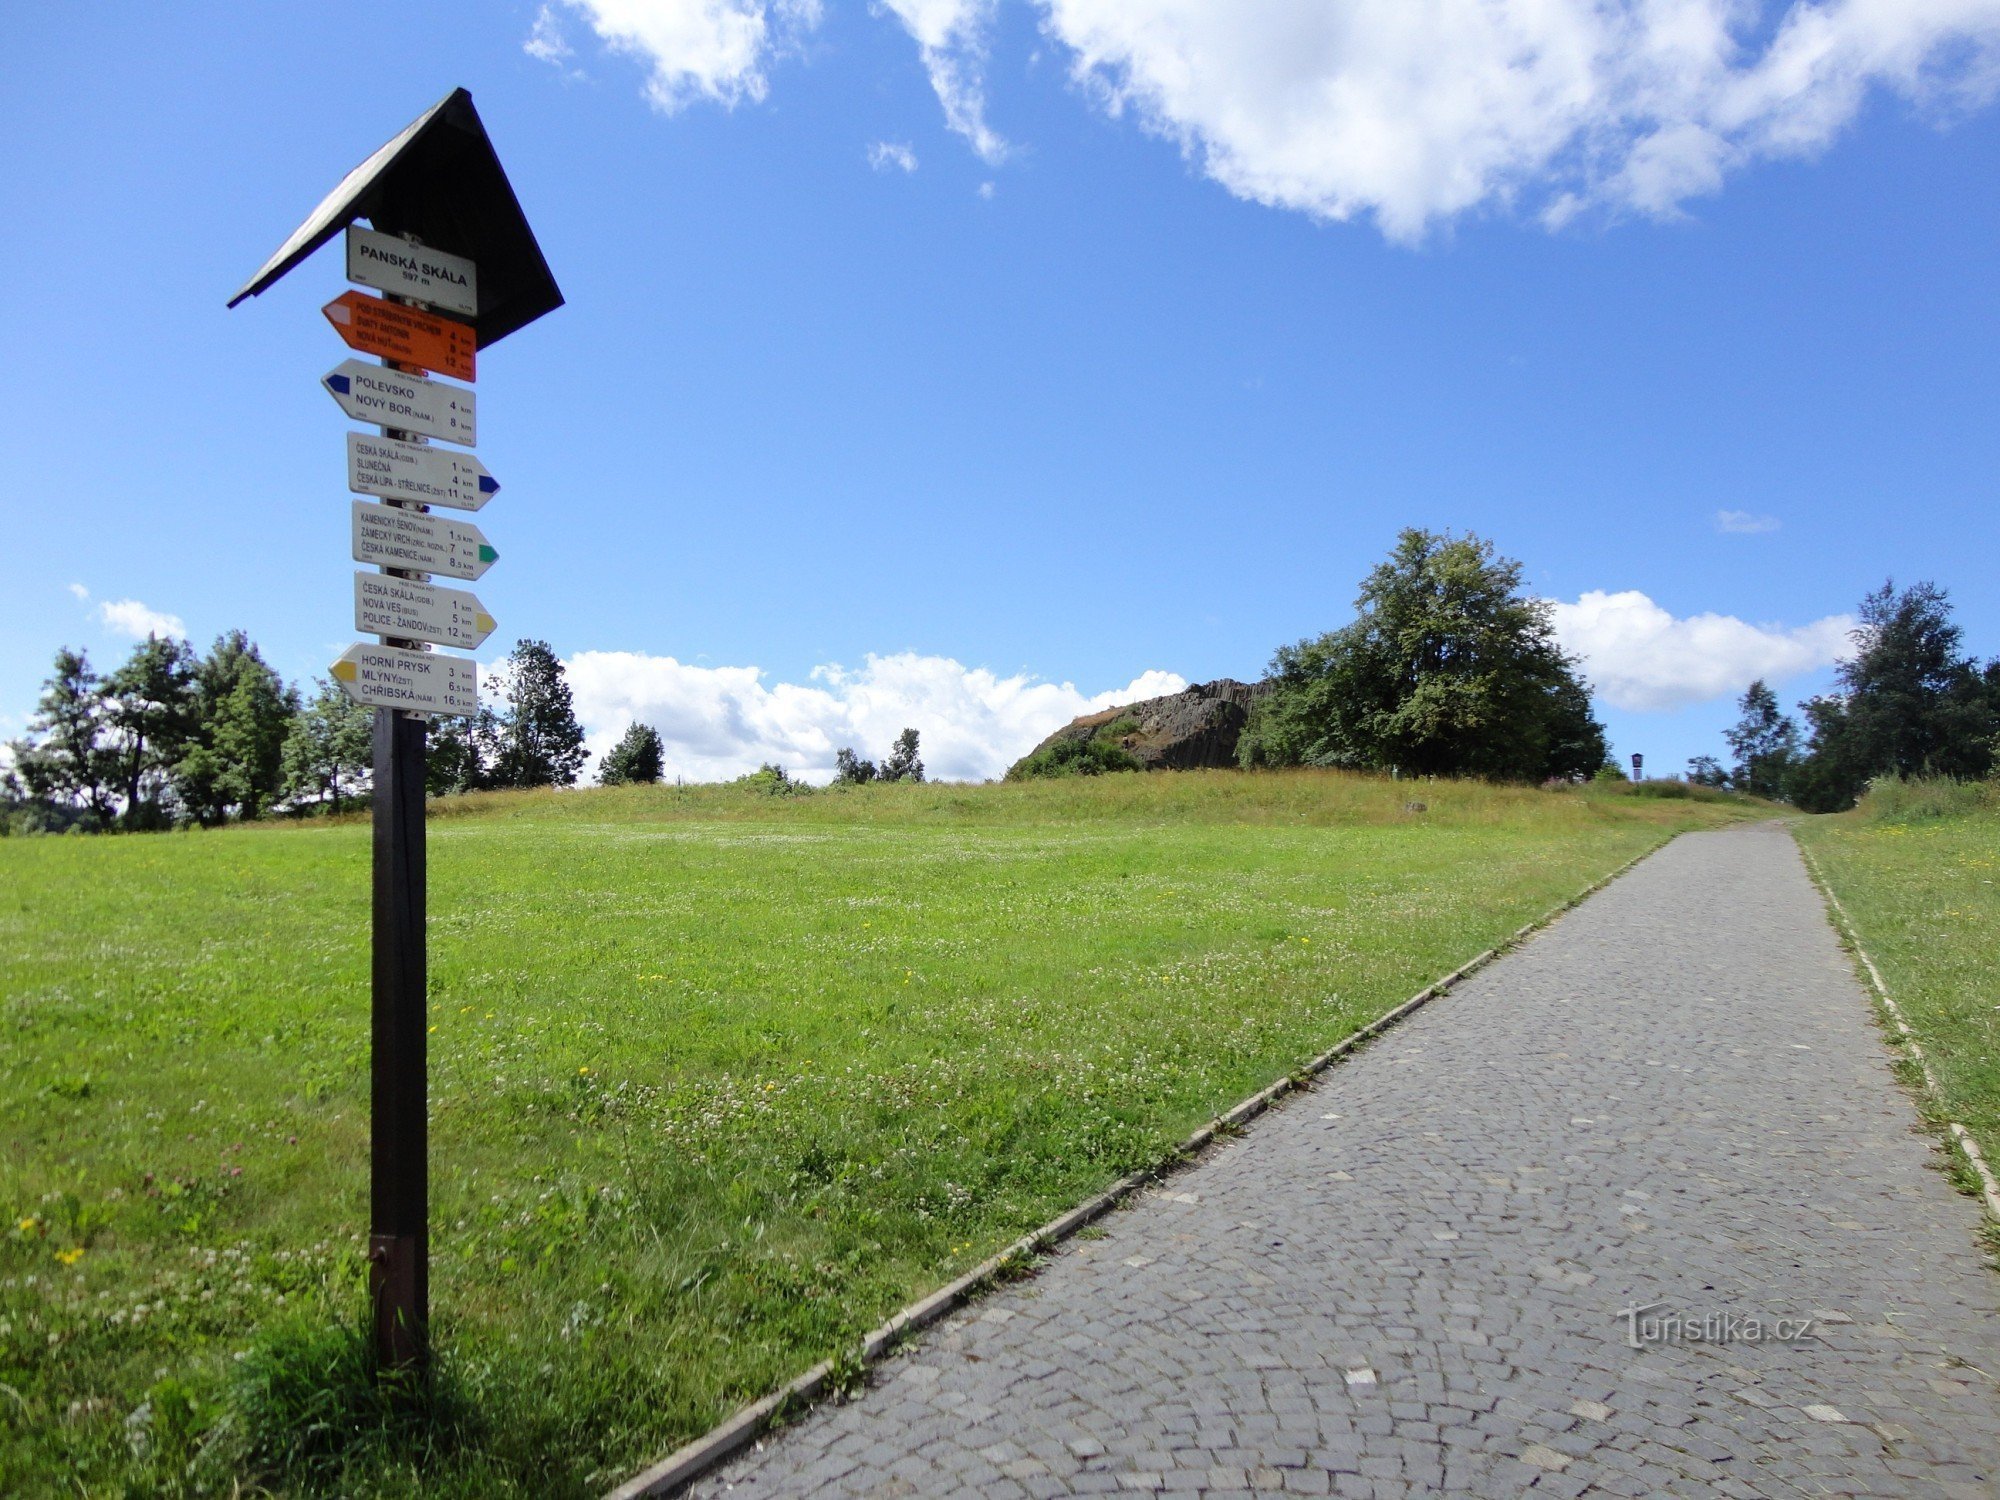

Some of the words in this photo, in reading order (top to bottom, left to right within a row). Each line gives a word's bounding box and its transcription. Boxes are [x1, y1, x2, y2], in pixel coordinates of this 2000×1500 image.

[360, 246, 418, 271] PANSKÁ
[422, 263, 467, 287] SKÁLA
[403, 271, 418, 283] 597
[422, 277, 429, 285] m
[356, 375, 414, 399] POLEVSKO
[450, 401, 456, 410] 4
[461, 406, 472, 414] km
[356, 394, 385, 410] NOVÝ
[389, 403, 411, 415] BOR
[450, 418, 456, 427] 8
[356, 443, 377, 456] ČESKÁ
[379, 447, 399, 460] SKÁLA
[452, 463, 456, 471] 1
[462, 466, 472, 474] km
[357, 458, 391, 473] SLUNEČNÁ
[452, 476, 458, 485] 4
[463, 480, 473, 488] km
[357, 472, 378, 485] ČESKÁ
[379, 476, 393, 487] LÍPA
[398, 478, 431, 493] STŘELNICE
[448, 489, 458, 498] 11
[463, 493, 474, 501] km
[361, 513, 395, 529] KAMENICKÝ
[361, 527, 392, 542] ZÁMECKÝ
[394, 533, 410, 544] VRCH
[450, 544, 455, 552] 7
[463, 549, 473, 557] km
[362, 541, 383, 554] ČESKÁ
[385, 546, 417, 560] KAMENICE
[463, 562, 473, 570] km
[363, 582, 388, 596] ČESKÁ
[390, 588, 414, 601] SKÁLA
[452, 601, 457, 609] 1
[363, 598, 384, 611] NOVÁ
[387, 602, 401, 613] VES
[452, 614, 458, 623] 5
[462, 618, 472, 626] km
[363, 612, 390, 625] POLICE
[397, 616, 427, 632] ŽANDOV
[448, 627, 458, 637] 12
[462, 631, 472, 639] km
[362, 655, 395, 668] HORNÍ
[398, 660, 431, 674] PRYSK
[449, 668, 454, 677] 3
[362, 669, 396, 683] MLÝNY
[362, 683, 415, 699] CHŘIBSKÁ
[463, 699, 472, 707] km
